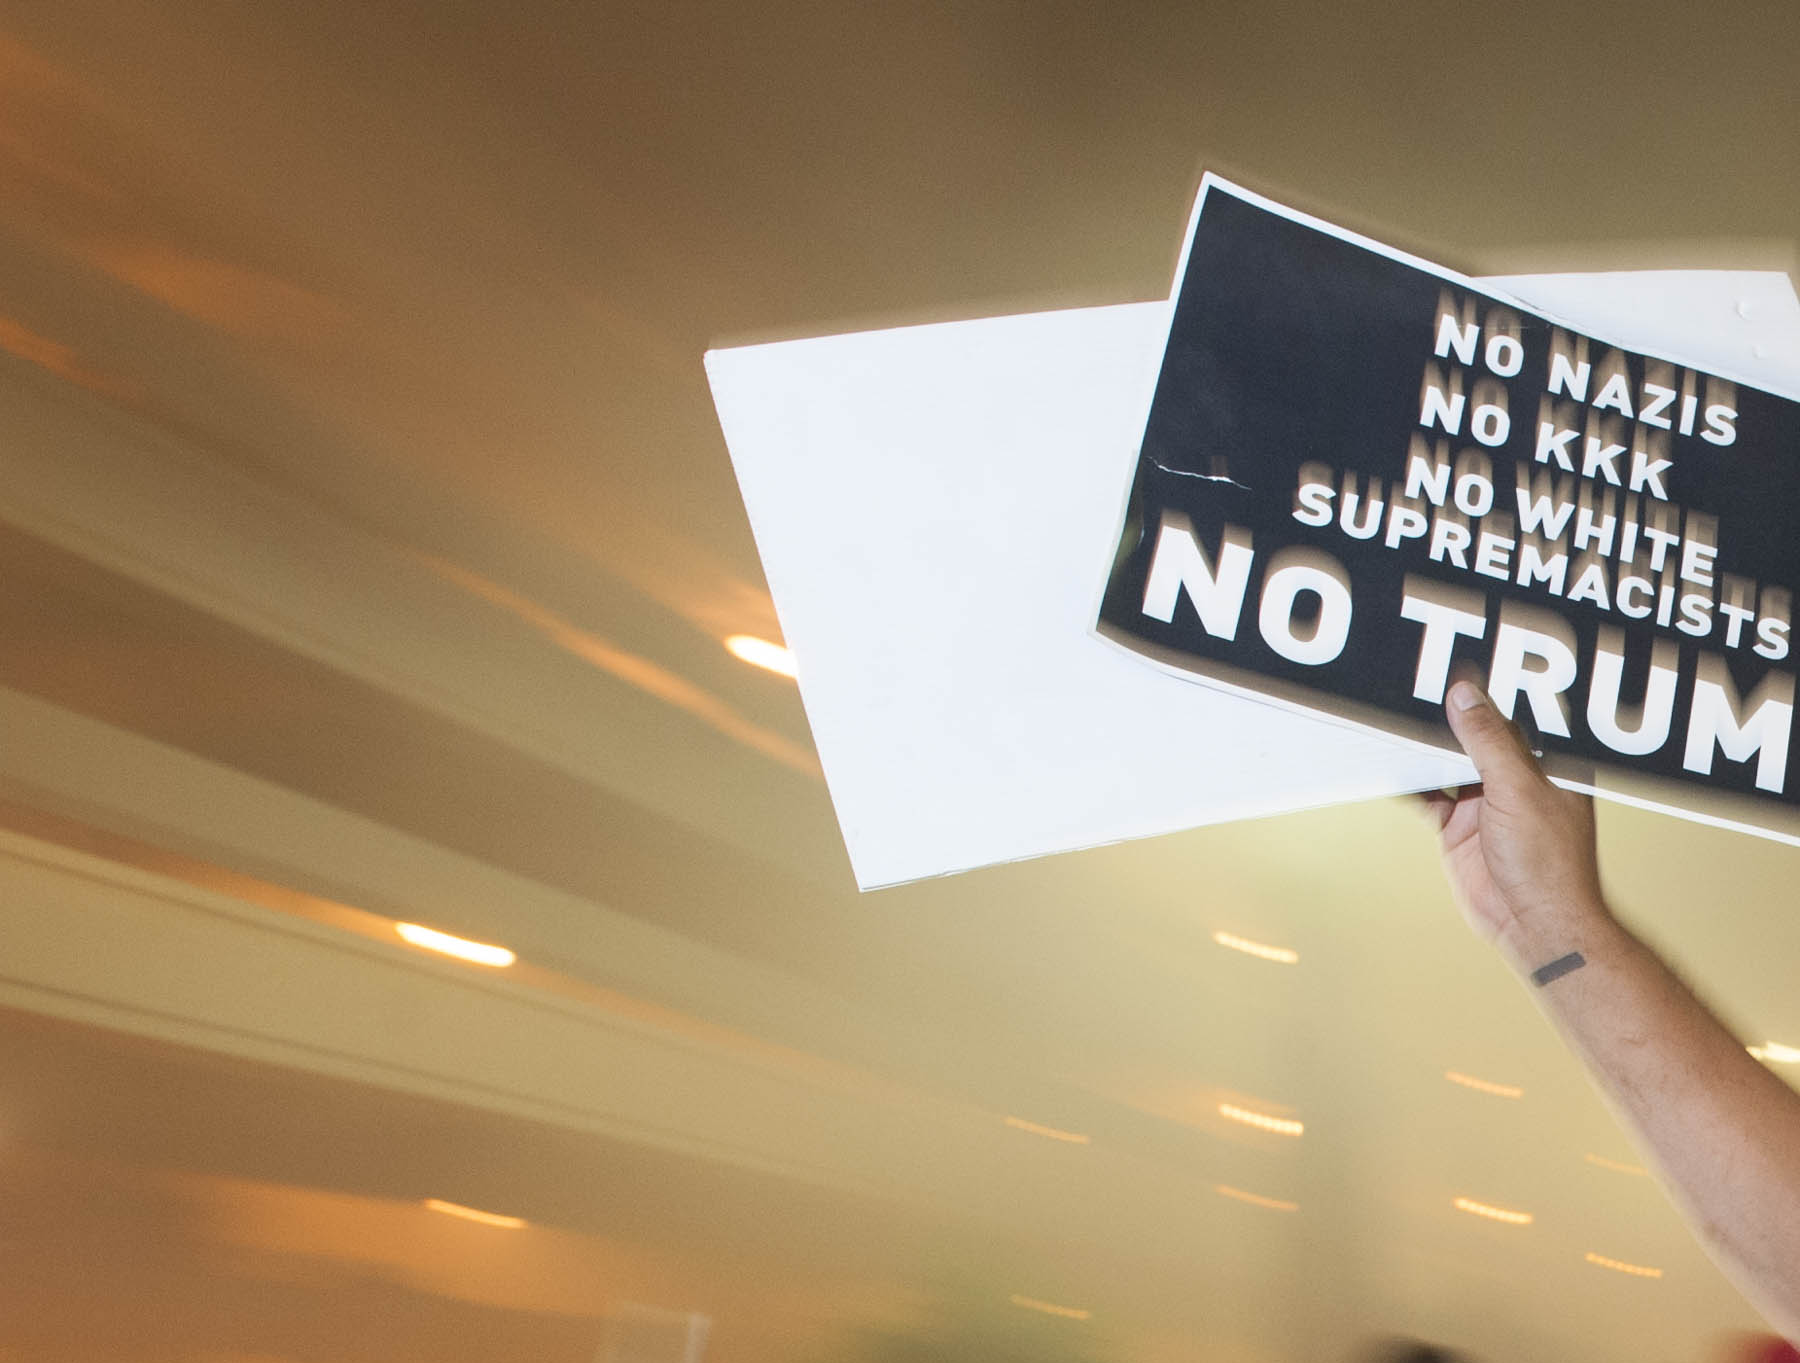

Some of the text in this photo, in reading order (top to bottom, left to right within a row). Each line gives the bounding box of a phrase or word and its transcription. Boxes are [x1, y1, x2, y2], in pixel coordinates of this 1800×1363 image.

[1420, 386, 1674, 500] NO KKK
[1434, 314, 1738, 447] NO NAZIS
[1292, 483, 1791, 660] SUPREMACISTS
[1405, 456, 1718, 587] NO WHITE
[1141, 525, 1353, 666] NO
